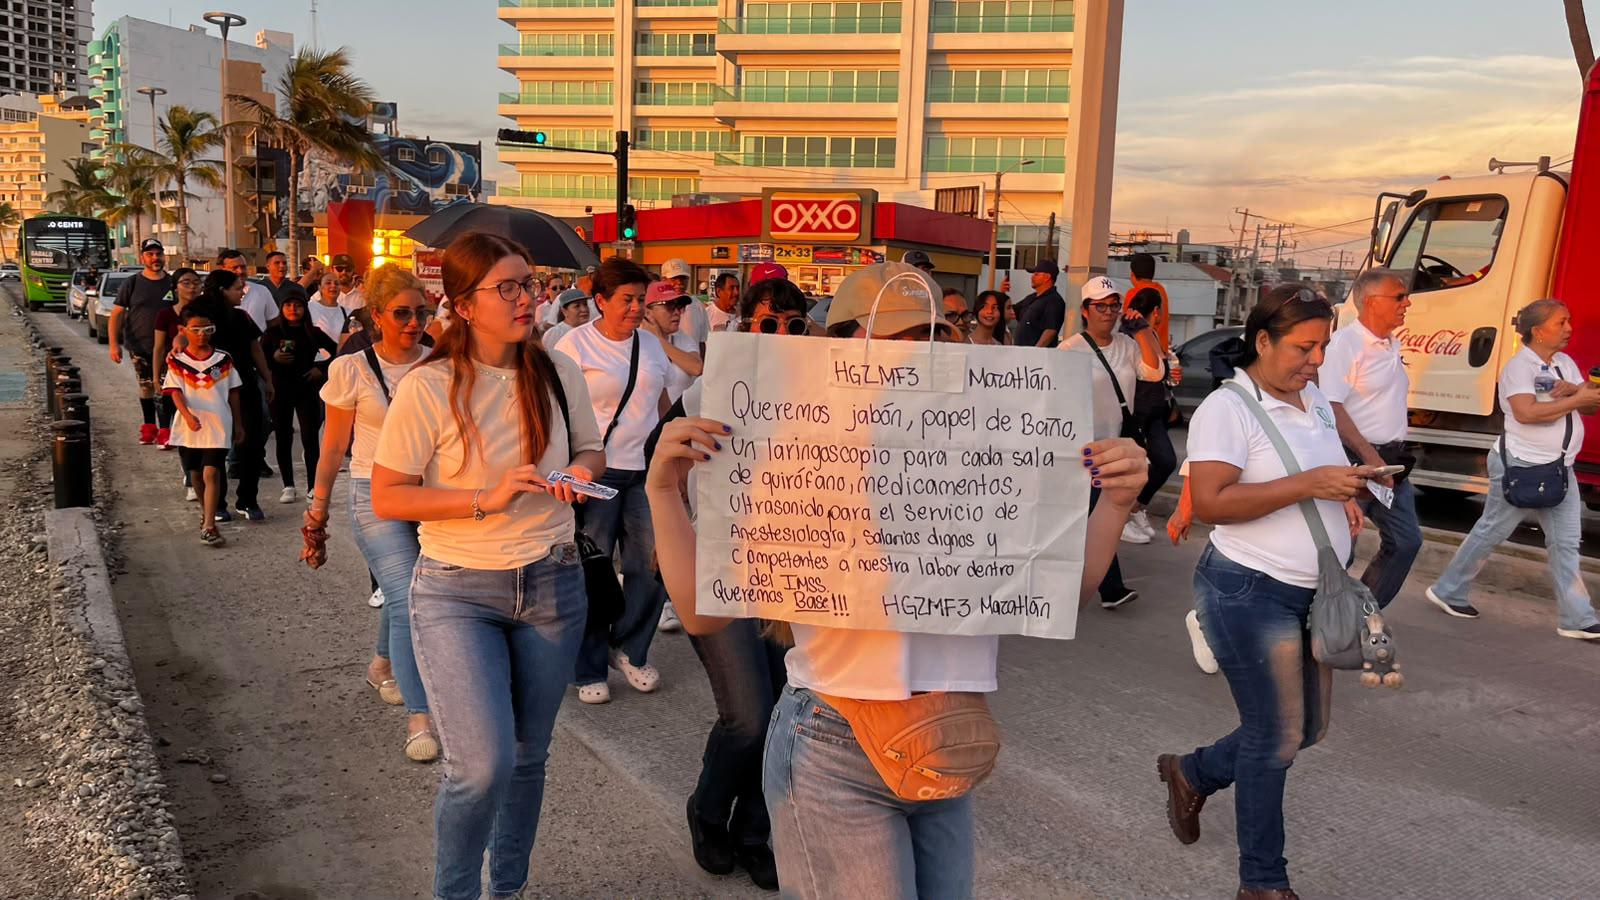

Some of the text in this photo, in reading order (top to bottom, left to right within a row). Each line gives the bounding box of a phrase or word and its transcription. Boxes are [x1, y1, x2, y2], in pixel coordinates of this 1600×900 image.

[773, 200, 857, 232] OXXO
[834, 361, 920, 386] HGZMF3
[732, 380, 1076, 440] Queremos jabón, papel de Baño,
[904, 450, 947, 472] para
[962, 444, 1002, 466] cada
[1012, 446, 1054, 468] sala
[729, 462, 752, 485] de
[827, 504, 871, 532] para
[880, 503, 895, 522] el
[995, 502, 1018, 520] de
[928, 527, 974, 555] dignos
[987, 532, 998, 557] y
[838, 561, 850, 572] a
[918, 556, 960, 577] labor
[966, 560, 1014, 578] dentro
[712, 579, 784, 604] Queremos
[750, 568, 830, 593] del IMSS.
[882, 594, 1050, 620] HGZMF3 Mazatlán
